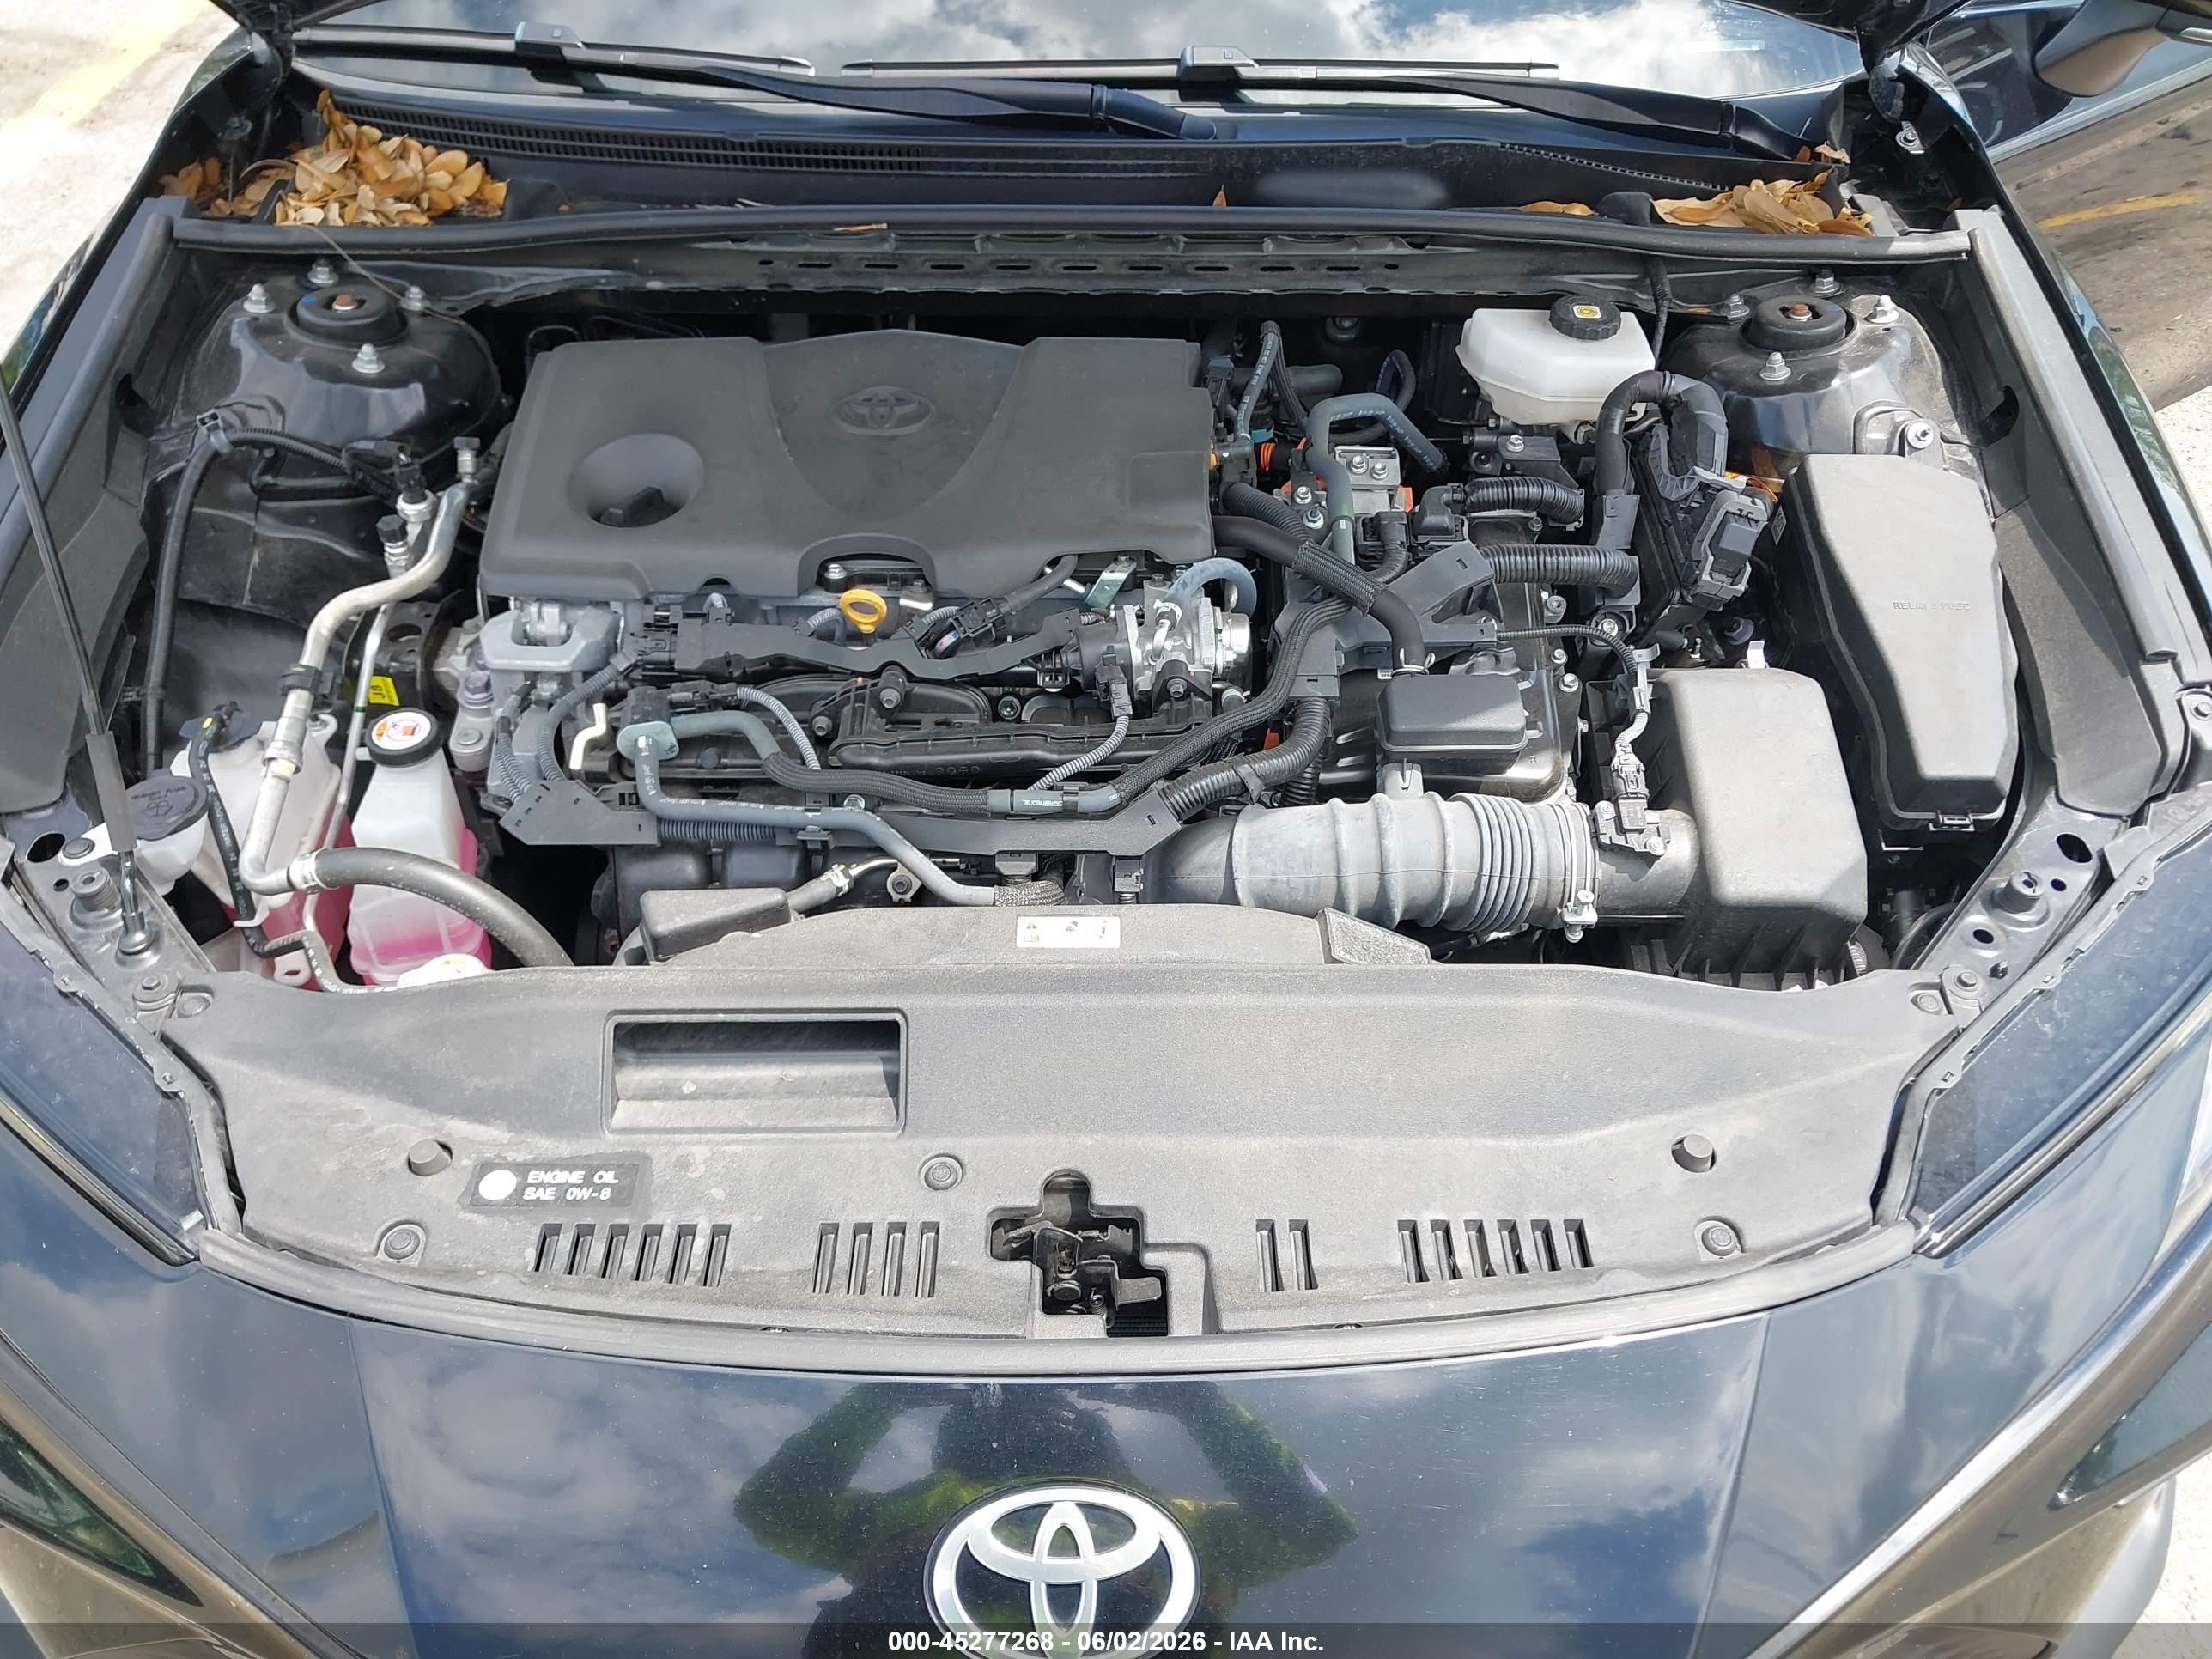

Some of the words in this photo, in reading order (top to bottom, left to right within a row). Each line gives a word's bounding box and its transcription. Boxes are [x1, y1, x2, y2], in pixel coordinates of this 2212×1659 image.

[1892, 601, 1927, 611] RELAY
[526, 1170, 586, 1184] ENGINE
[592, 1170, 619, 1184] OIL
[522, 1186, 557, 1200] SAE
[566, 1186, 611, 1201] 0W-8
